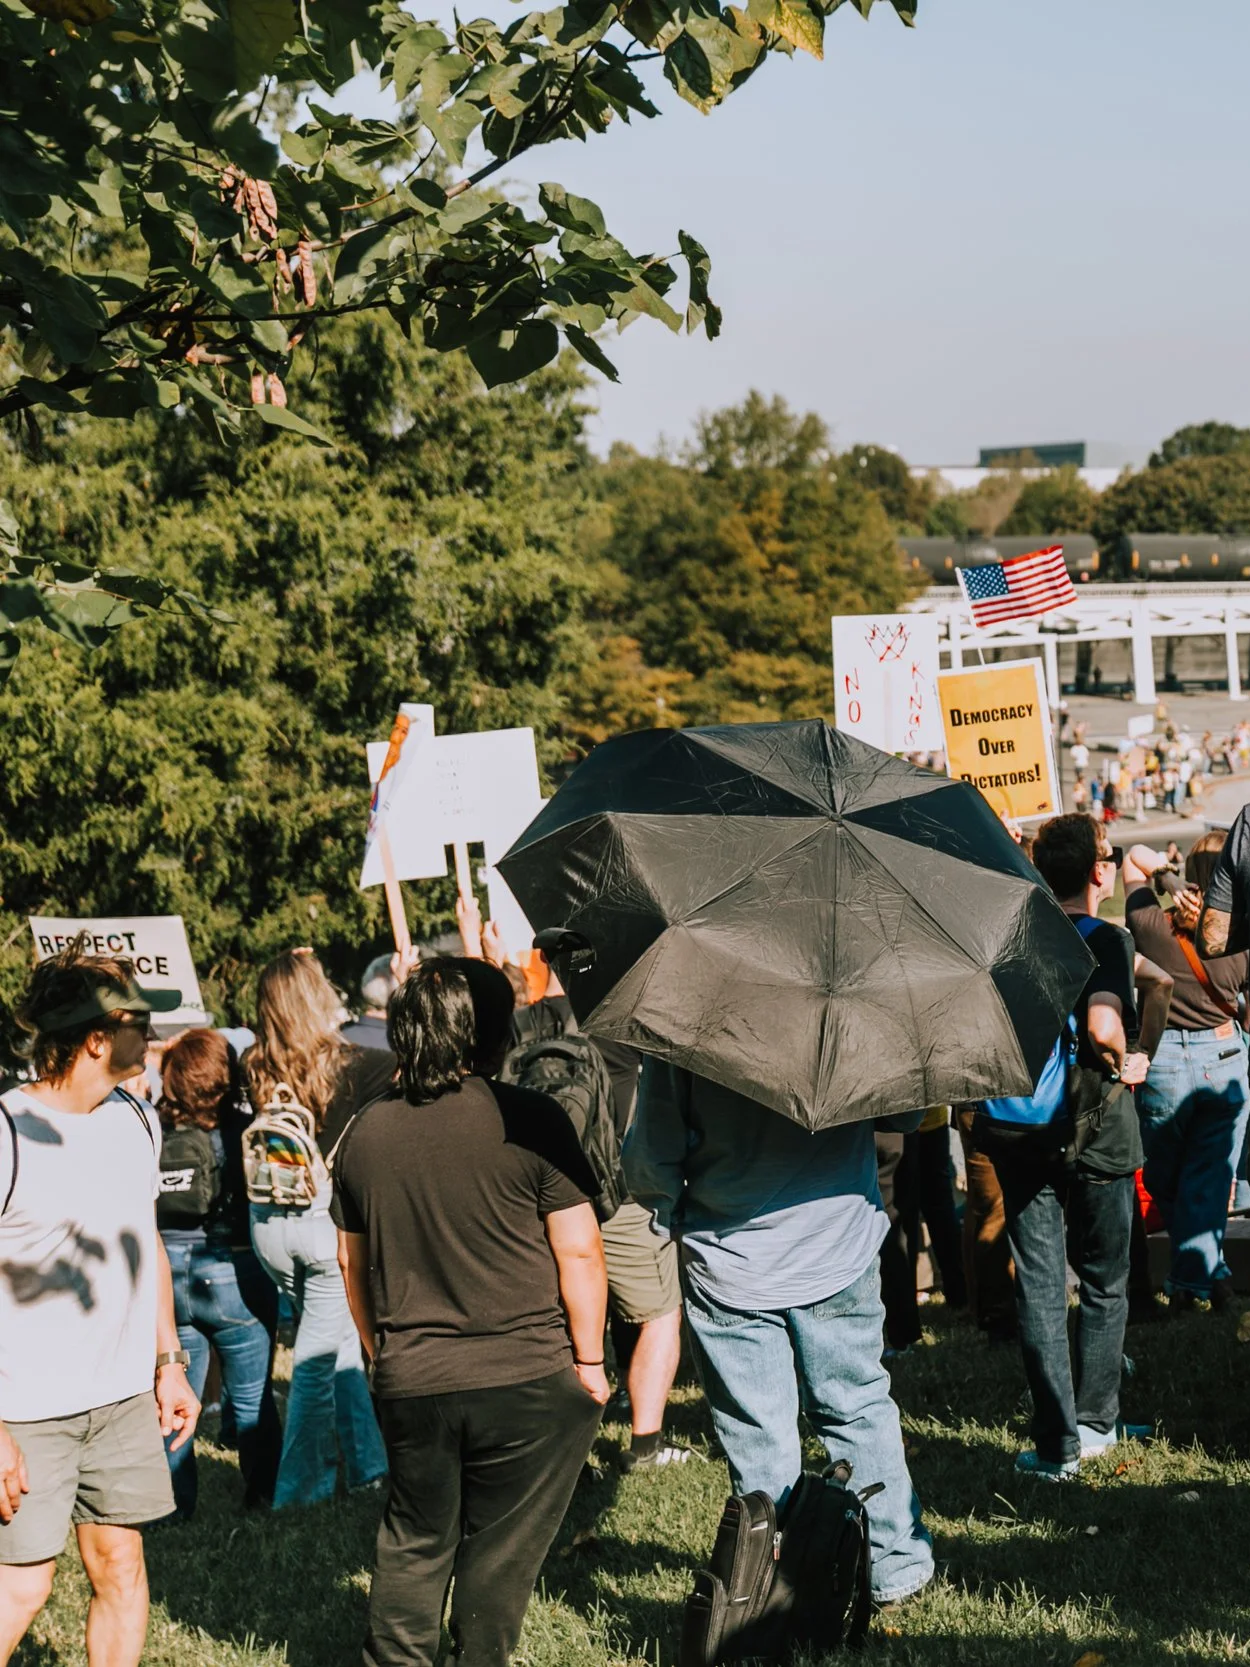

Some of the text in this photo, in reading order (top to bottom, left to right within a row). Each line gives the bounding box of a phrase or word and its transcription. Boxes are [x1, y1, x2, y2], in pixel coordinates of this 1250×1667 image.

[844, 667, 862, 724] NO
[950, 704, 1034, 728] DEMOCRACY
[978, 737, 1016, 757] OVER
